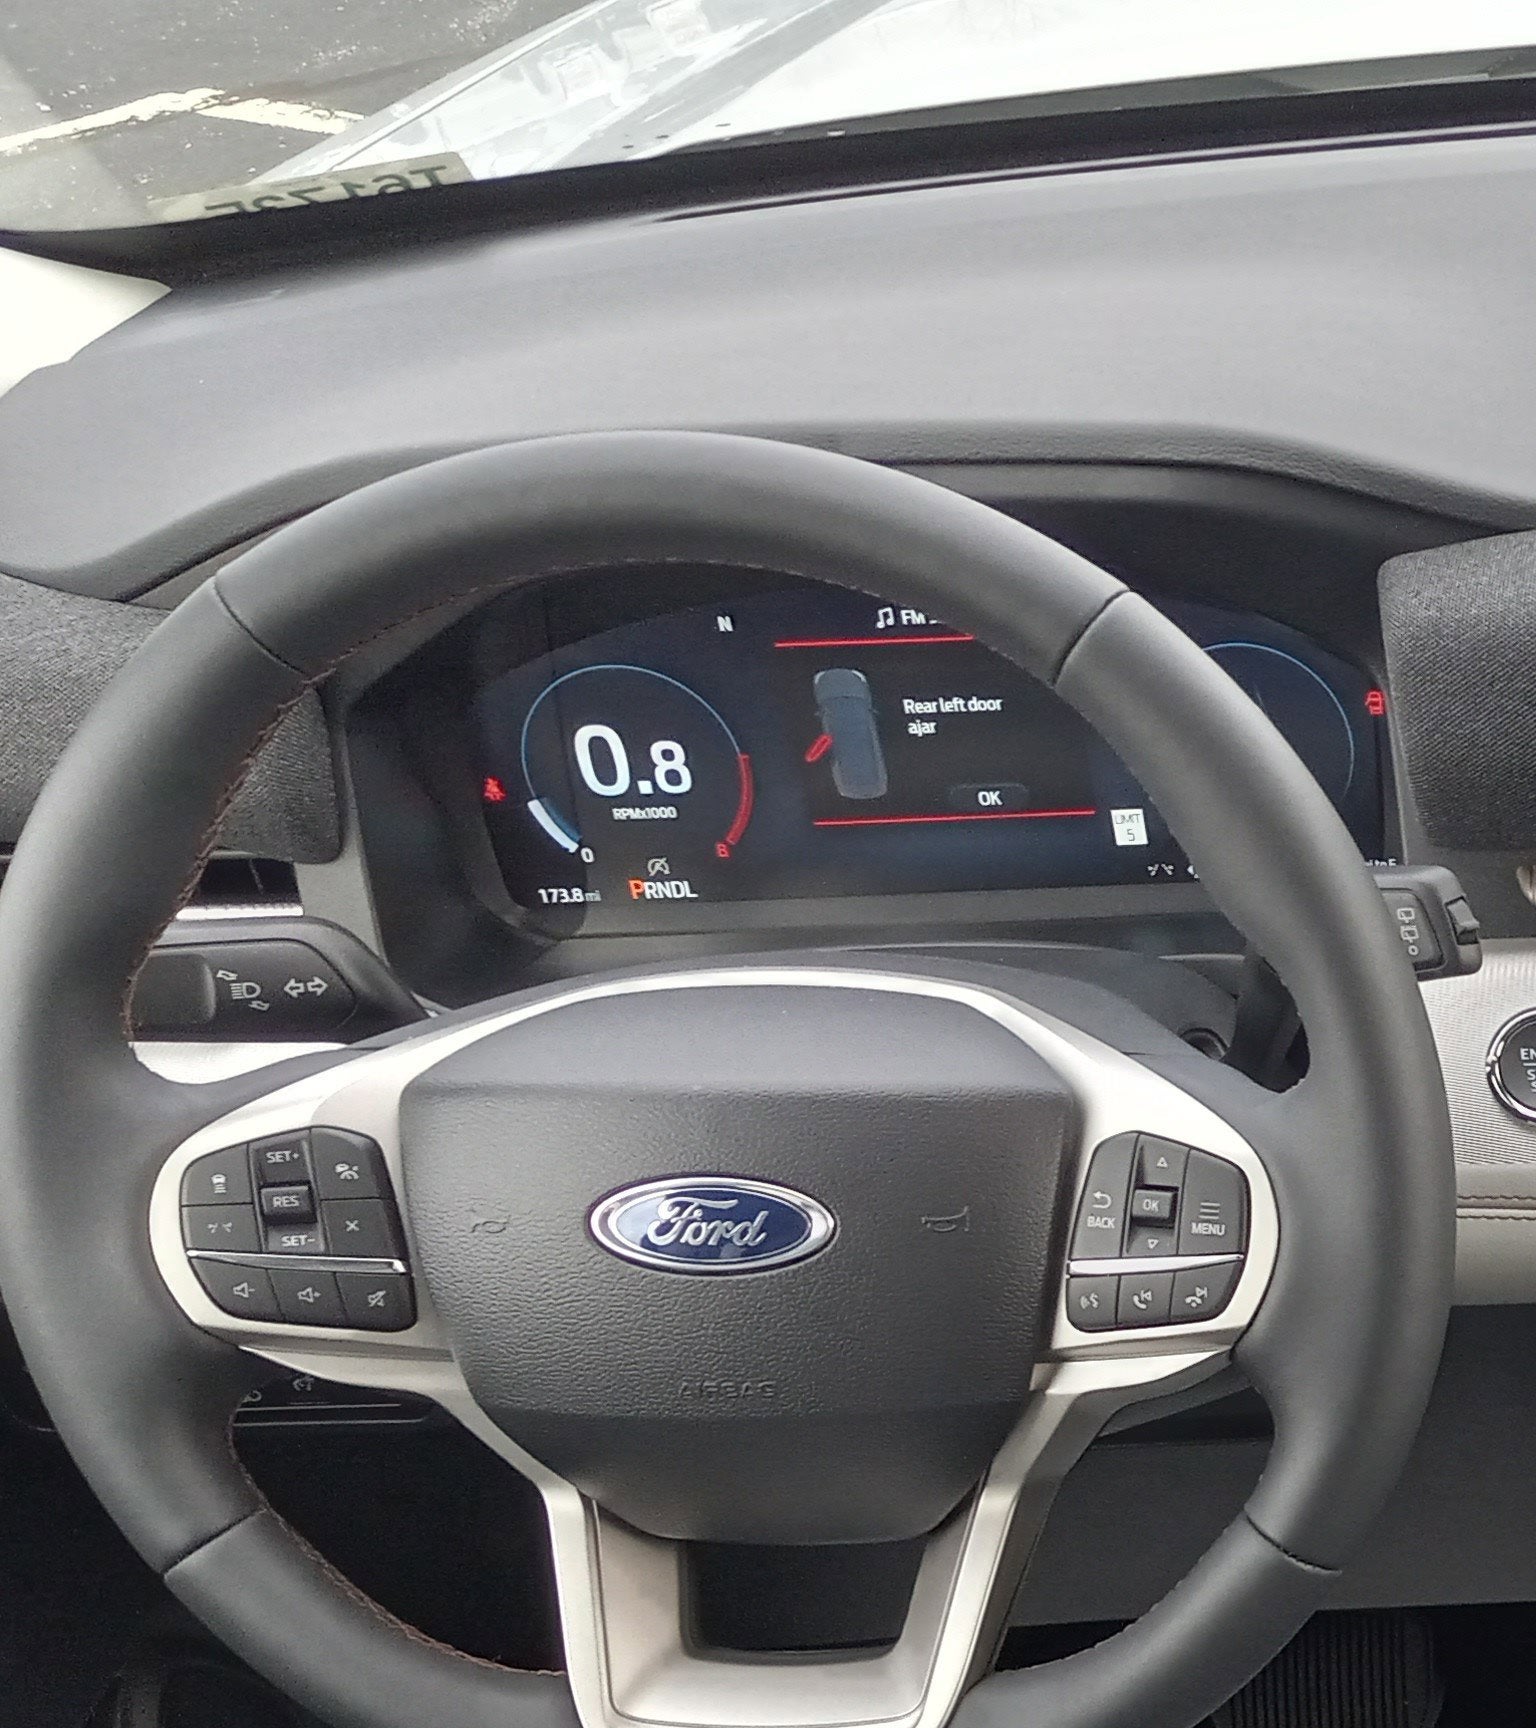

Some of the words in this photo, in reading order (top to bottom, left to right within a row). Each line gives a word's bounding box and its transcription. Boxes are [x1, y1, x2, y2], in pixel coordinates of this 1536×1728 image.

[716, 615, 734, 632] N
[900, 609, 926, 625] FM
[903, 698, 937, 715] Rear
[939, 697, 966, 714] left
[967, 697, 1004, 712] door
[908, 720, 937, 737] ajar
[573, 724, 693, 798] 0.8
[977, 790, 1003, 807] OK
[580, 847, 594, 863] 0
[538, 888, 585, 903] 173.8
[266, 1150, 300, 1164] SET+
[272, 1195, 299, 1208] RES
[1142, 1199, 1159, 1213] OK
[646, 1196, 768, 1248] Ford
[1087, 1216, 1116, 1229] BACK
[1191, 1223, 1226, 1237] MENU
